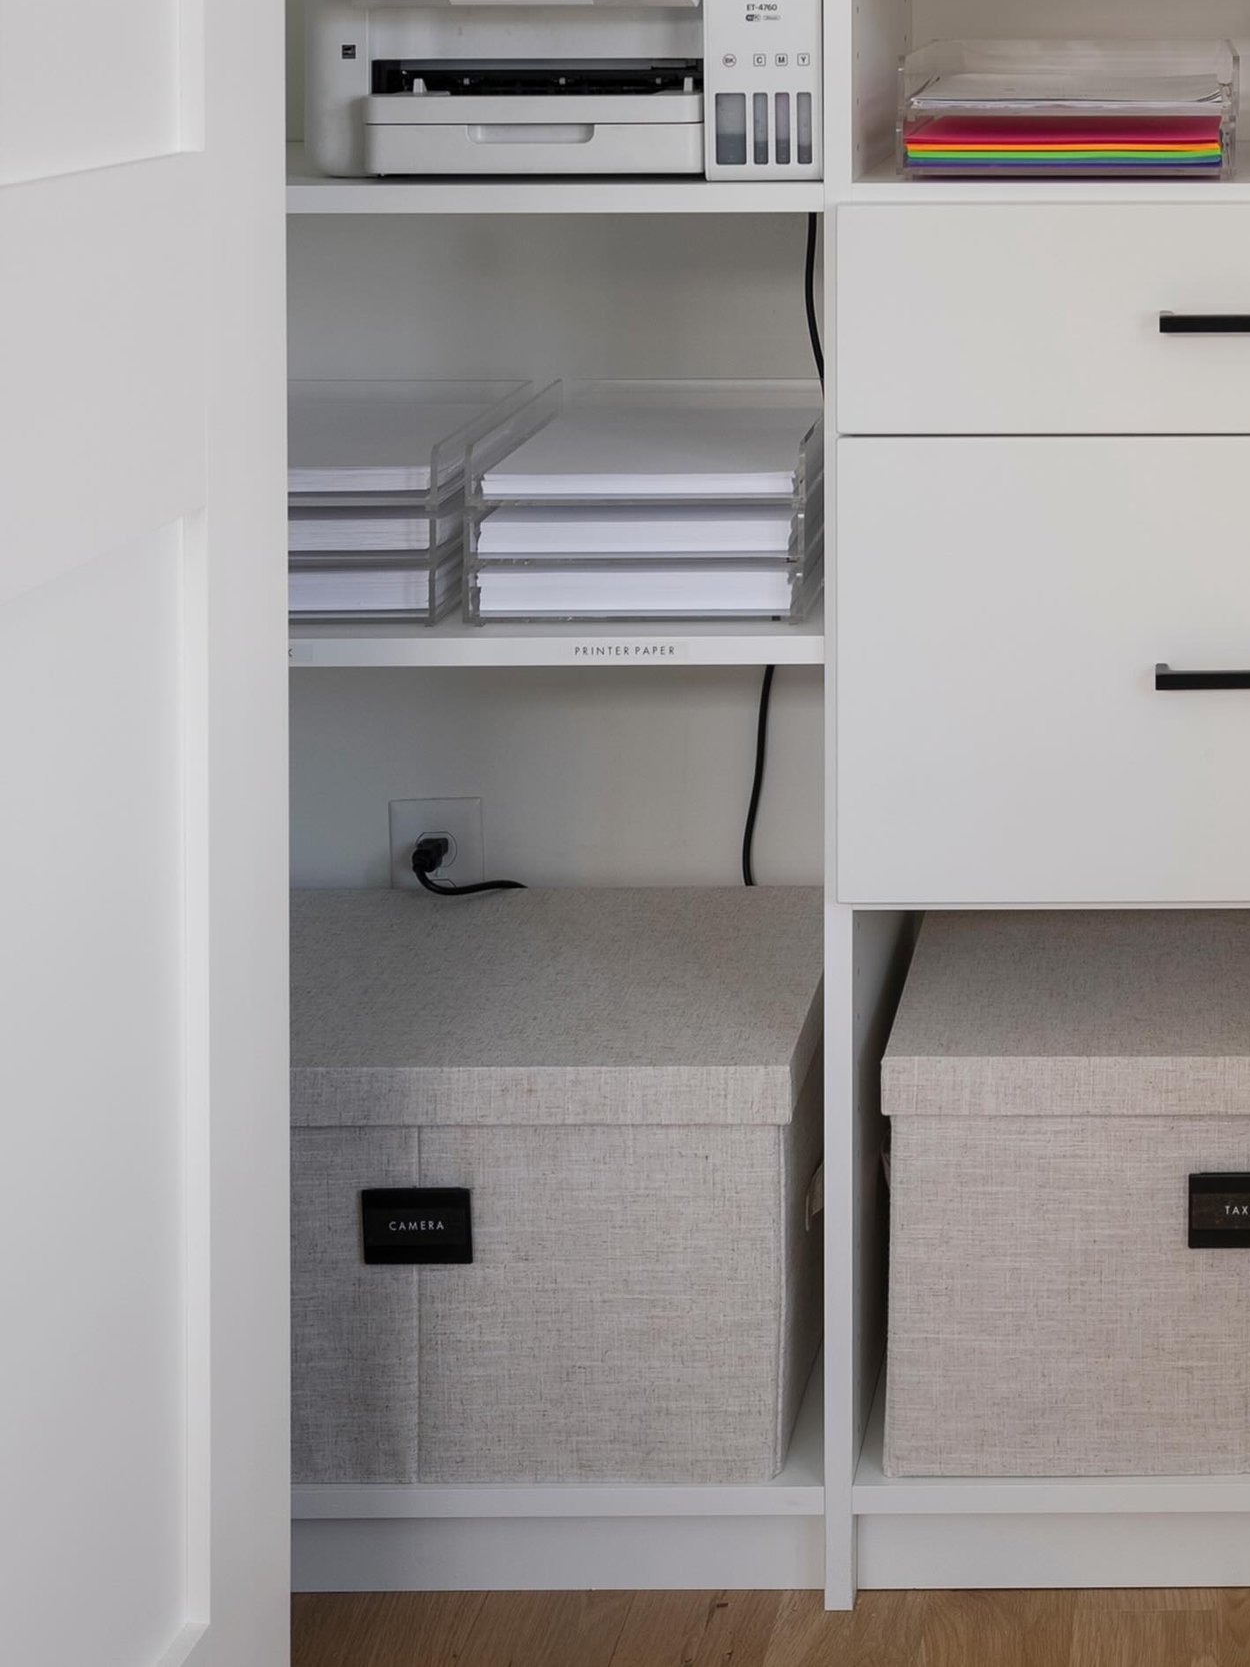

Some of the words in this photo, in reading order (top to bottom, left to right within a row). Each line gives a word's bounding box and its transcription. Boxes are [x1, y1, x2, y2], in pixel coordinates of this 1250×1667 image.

[746, 3, 778, 11] ET-4760
[574, 645, 630, 656] PRINTER
[634, 645, 675, 656] PAPER
[388, 1220, 445, 1231] CAMERA
